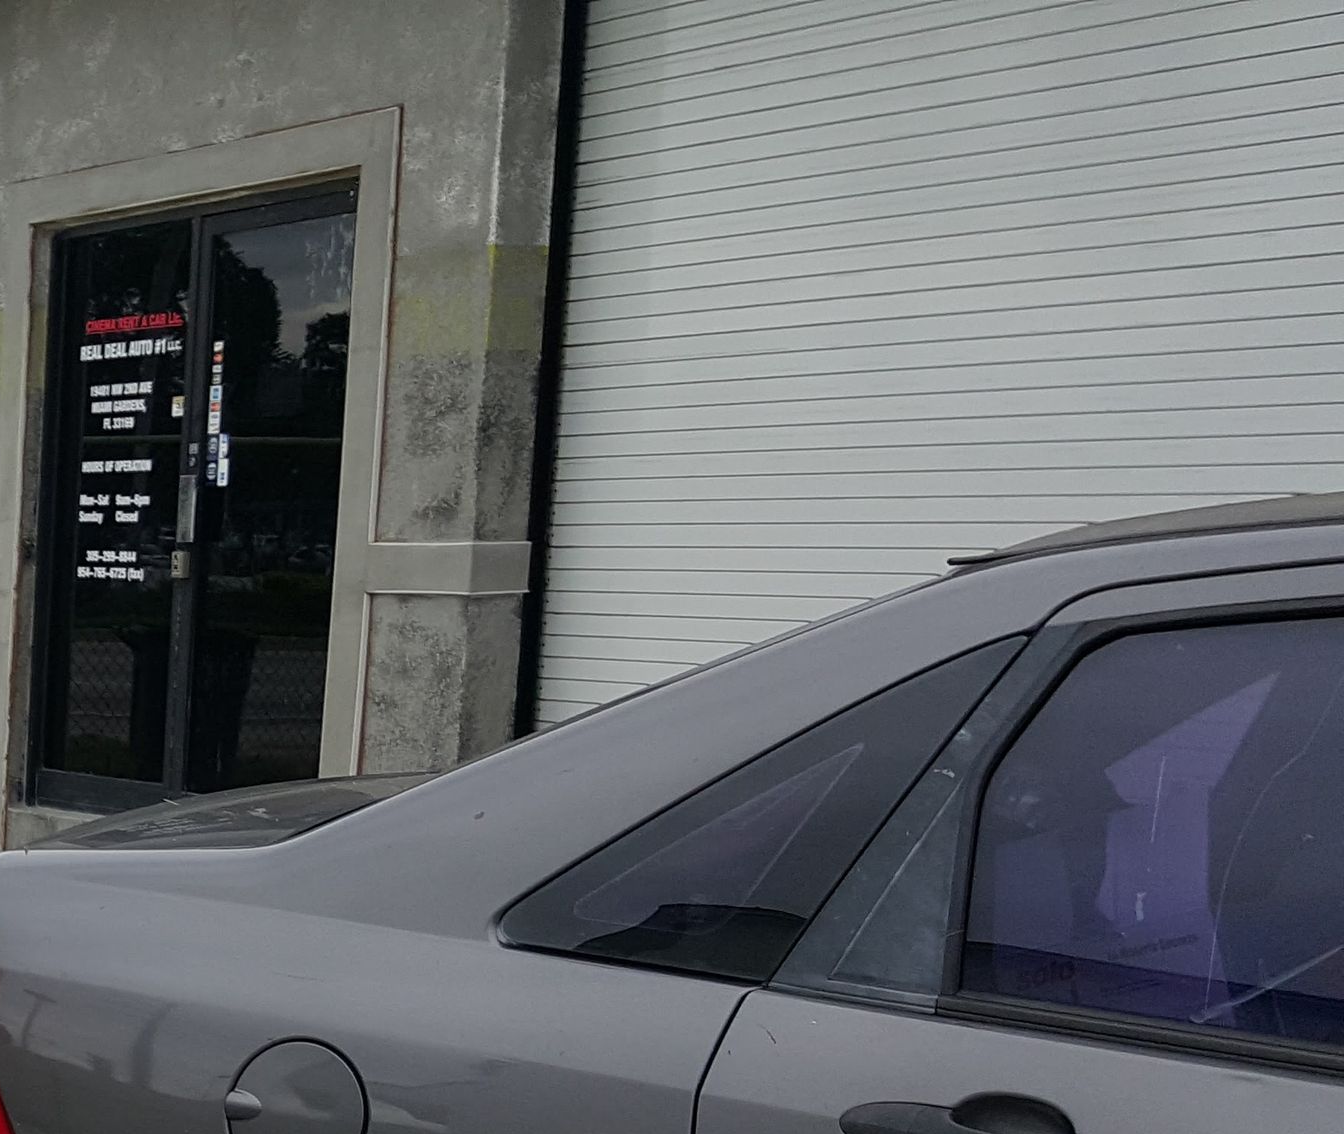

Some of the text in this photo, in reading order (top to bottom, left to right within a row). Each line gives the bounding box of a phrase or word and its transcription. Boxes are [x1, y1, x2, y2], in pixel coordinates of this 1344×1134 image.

[150, 313, 167, 326] CAR
[79, 344, 103, 361] REAL
[104, 341, 128, 359] DEAL
[128, 339, 154, 357] AUTO
[154, 338, 167, 354] #1
[138, 381, 153, 394] AVE
[81, 458, 152, 473] HOURS OF OPERATION
[78, 510, 139, 525] Sunday Closed
